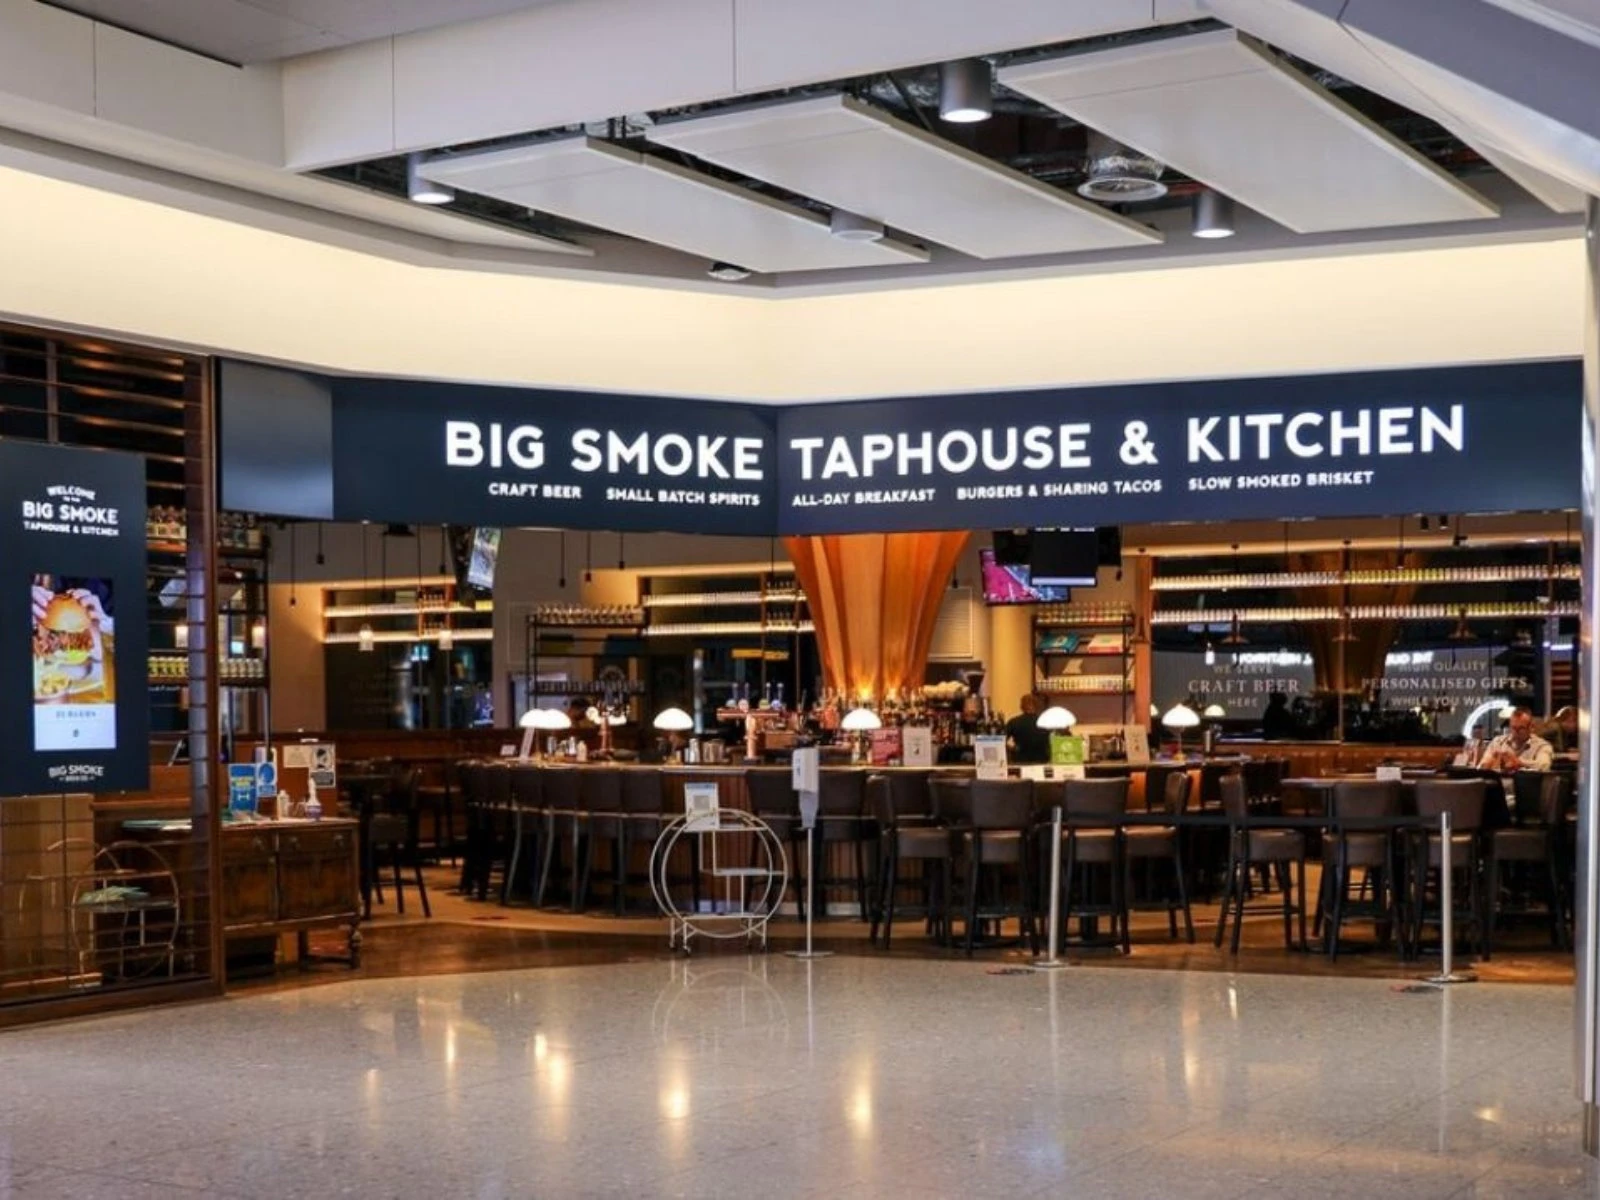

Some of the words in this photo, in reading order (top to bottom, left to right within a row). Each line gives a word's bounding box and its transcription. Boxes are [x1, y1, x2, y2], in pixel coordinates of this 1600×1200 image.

[446, 420, 544, 469] BIG
[571, 429, 763, 480] SMOKE
[790, 423, 1092, 480] TAPHOUSE
[1119, 420, 1158, 465] &
[1188, 405, 1463, 462] KITCHEN
[1188, 476, 1232, 491] SLOW
[1237, 474, 1302, 489] SMOKED
[1306, 470, 1375, 486] BRISKET
[46, 485, 96, 501] WELCOME
[489, 483, 538, 497] CRAFT
[543, 485, 582, 499] BEER
[606, 487, 654, 502] SMALL
[658, 490, 705, 504] BATCH
[709, 492, 760, 506] SPIRITS
[792, 492, 850, 507] ALL-DAY
[854, 488, 936, 504] BREAKFAST
[957, 485, 1024, 500] BURGERS
[1028, 485, 1039, 497] &
[1043, 481, 1109, 497] SHARING
[1114, 480, 1162, 494] TACOS
[23, 500, 54, 519] BIG
[59, 504, 119, 525] SMOKE
[24, 521, 70, 533] TAPHOUSE
[81, 526, 119, 537] KITCHEN
[1433, 660, 1488, 673] QUALITY
[1188, 679, 1248, 693] CRAFT
[1253, 679, 1299, 693] BEER
[1361, 677, 1476, 690] PERSONALISED
[1480, 676, 1528, 689] GIFTS
[1433, 696, 1460, 707] YOU
[67, 764, 104, 777] SMOKE
